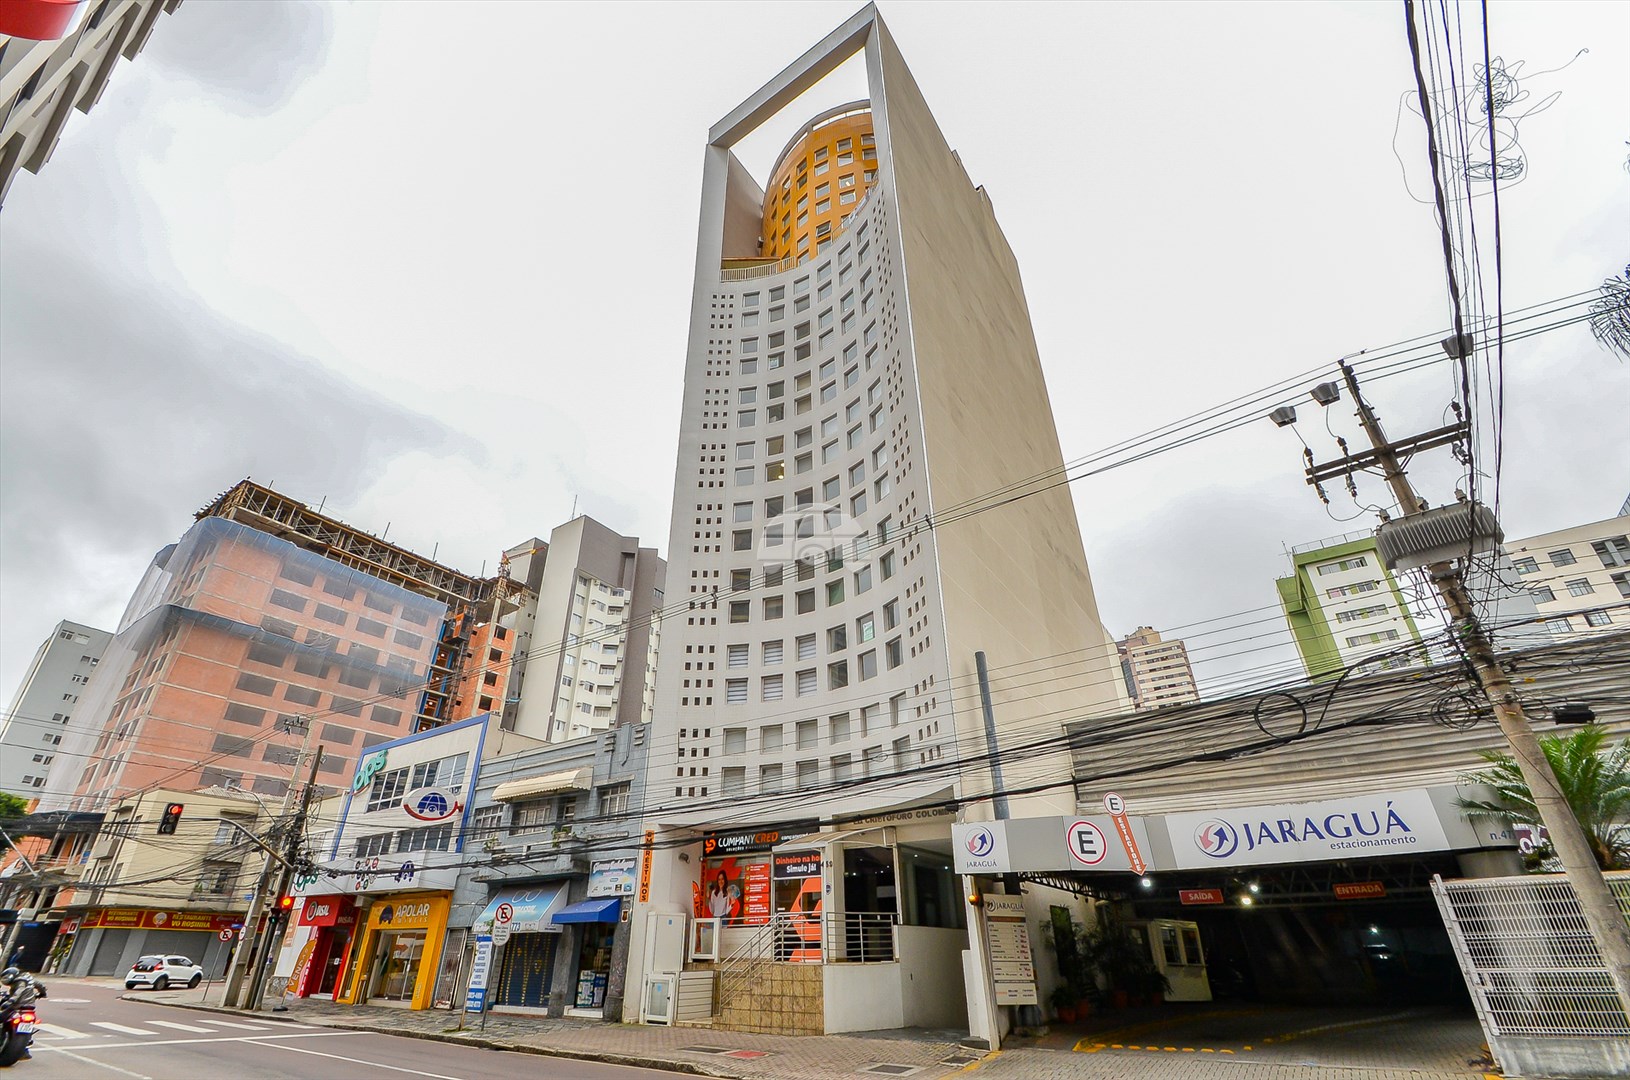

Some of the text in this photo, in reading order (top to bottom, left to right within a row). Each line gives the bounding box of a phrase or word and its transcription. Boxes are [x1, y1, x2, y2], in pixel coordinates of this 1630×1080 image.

[1109, 797, 1120, 811] E
[1243, 801, 1411, 851] JARAGUÁ
[1076, 830, 1097, 855] E
[1330, 835, 1417, 851] estacionamento
[775, 856, 802, 865] Dinheiro
[811, 854, 822, 862] ho
[966, 859, 998, 869] JARAGUÁ
[1188, 890, 1214, 901] SAÍDA
[1336, 884, 1382, 896] ENTRADA
[396, 903, 430, 917] APOLAR
